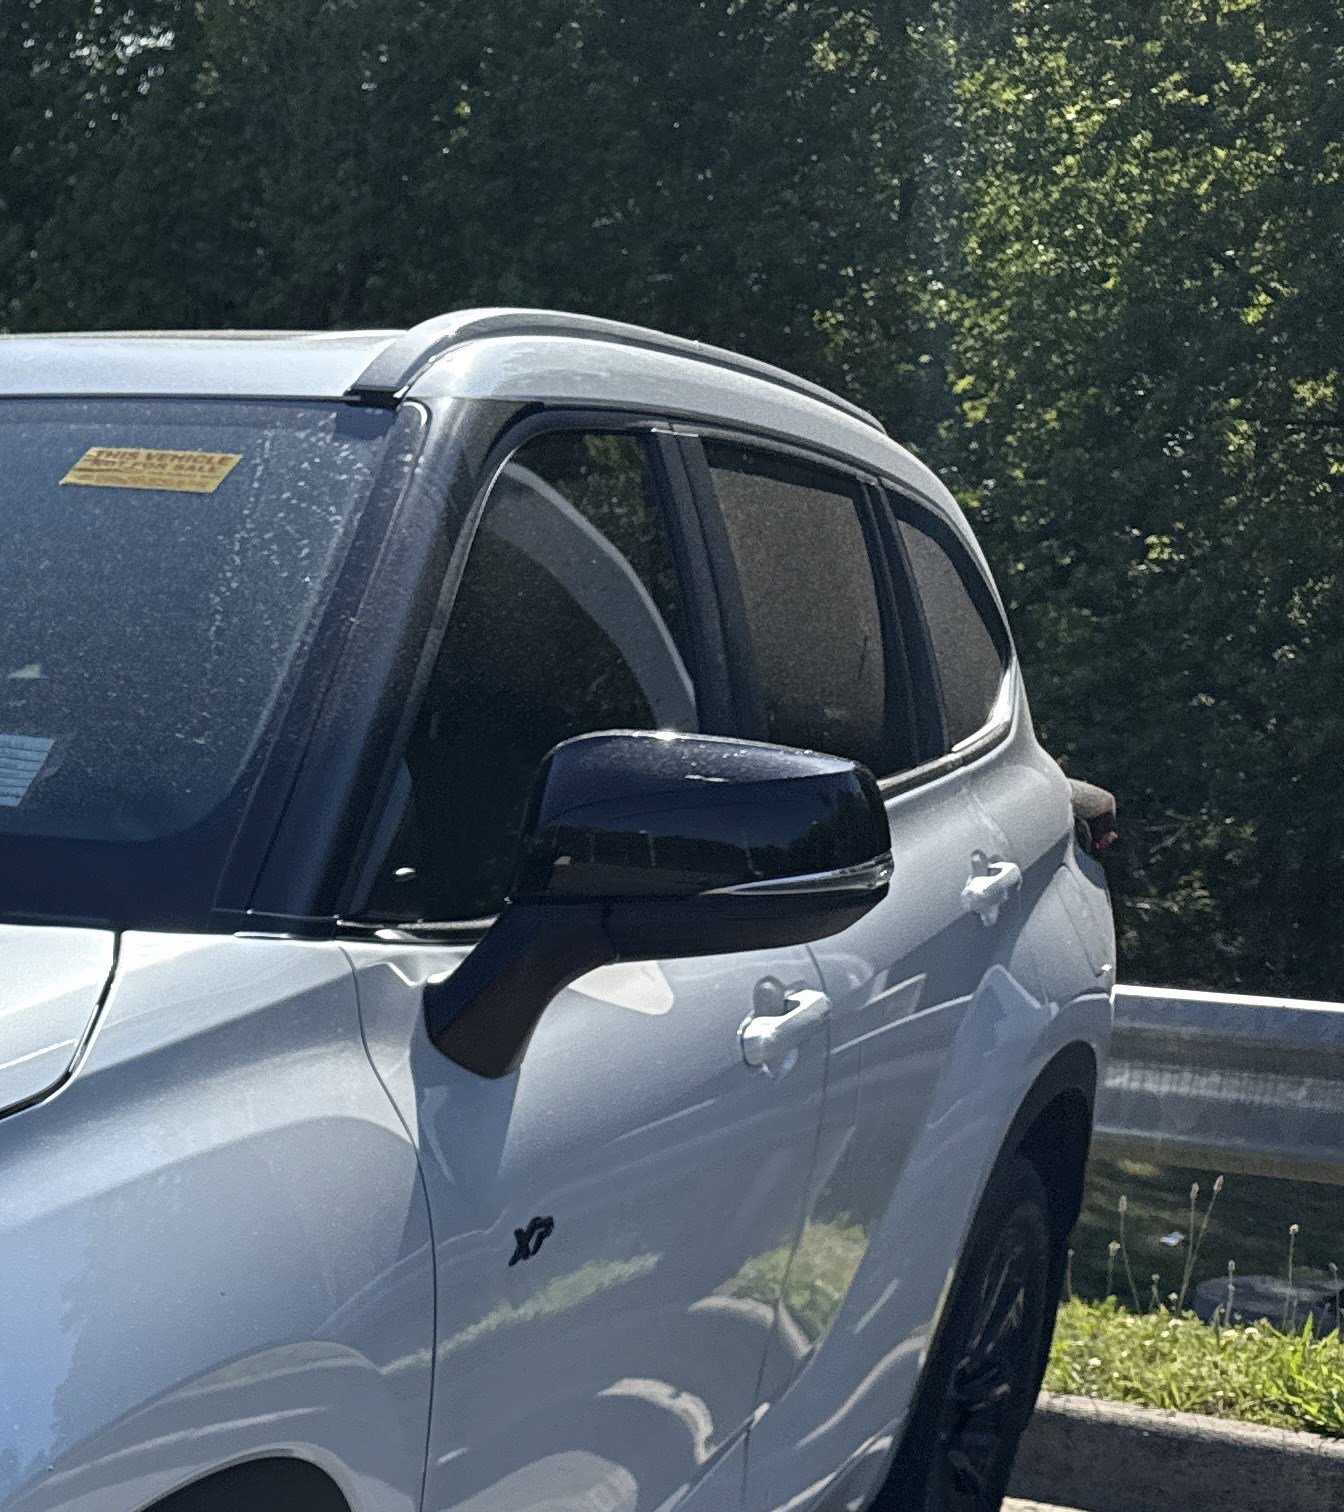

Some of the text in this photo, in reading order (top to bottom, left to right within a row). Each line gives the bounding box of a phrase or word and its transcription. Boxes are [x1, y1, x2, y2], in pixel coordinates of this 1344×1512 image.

[94, 450, 233, 465] THIS VEHICLE
[173, 463, 218, 473] SALE
